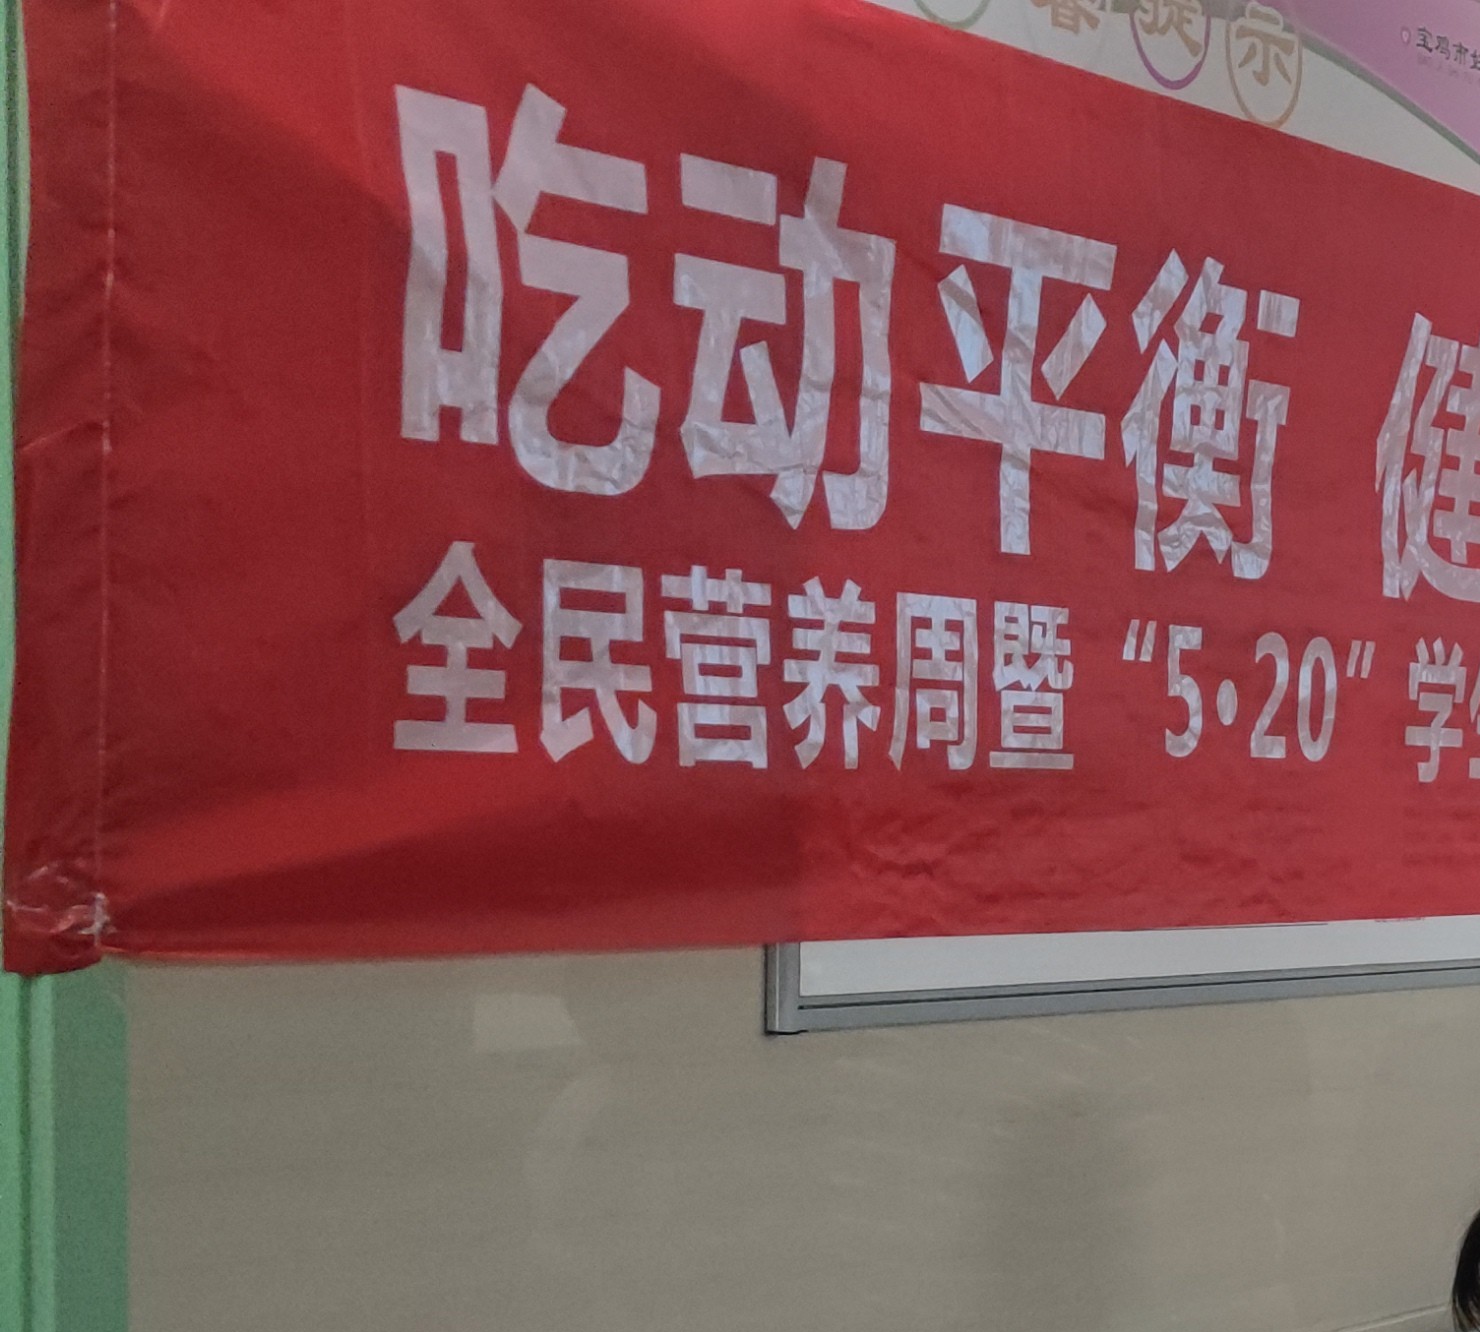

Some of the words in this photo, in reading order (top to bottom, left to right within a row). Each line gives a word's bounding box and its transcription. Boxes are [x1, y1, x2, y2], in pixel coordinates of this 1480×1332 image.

[395, 84, 1299, 580] 吃动平衡
[393, 541, 1074, 771] 全民营养周暨
